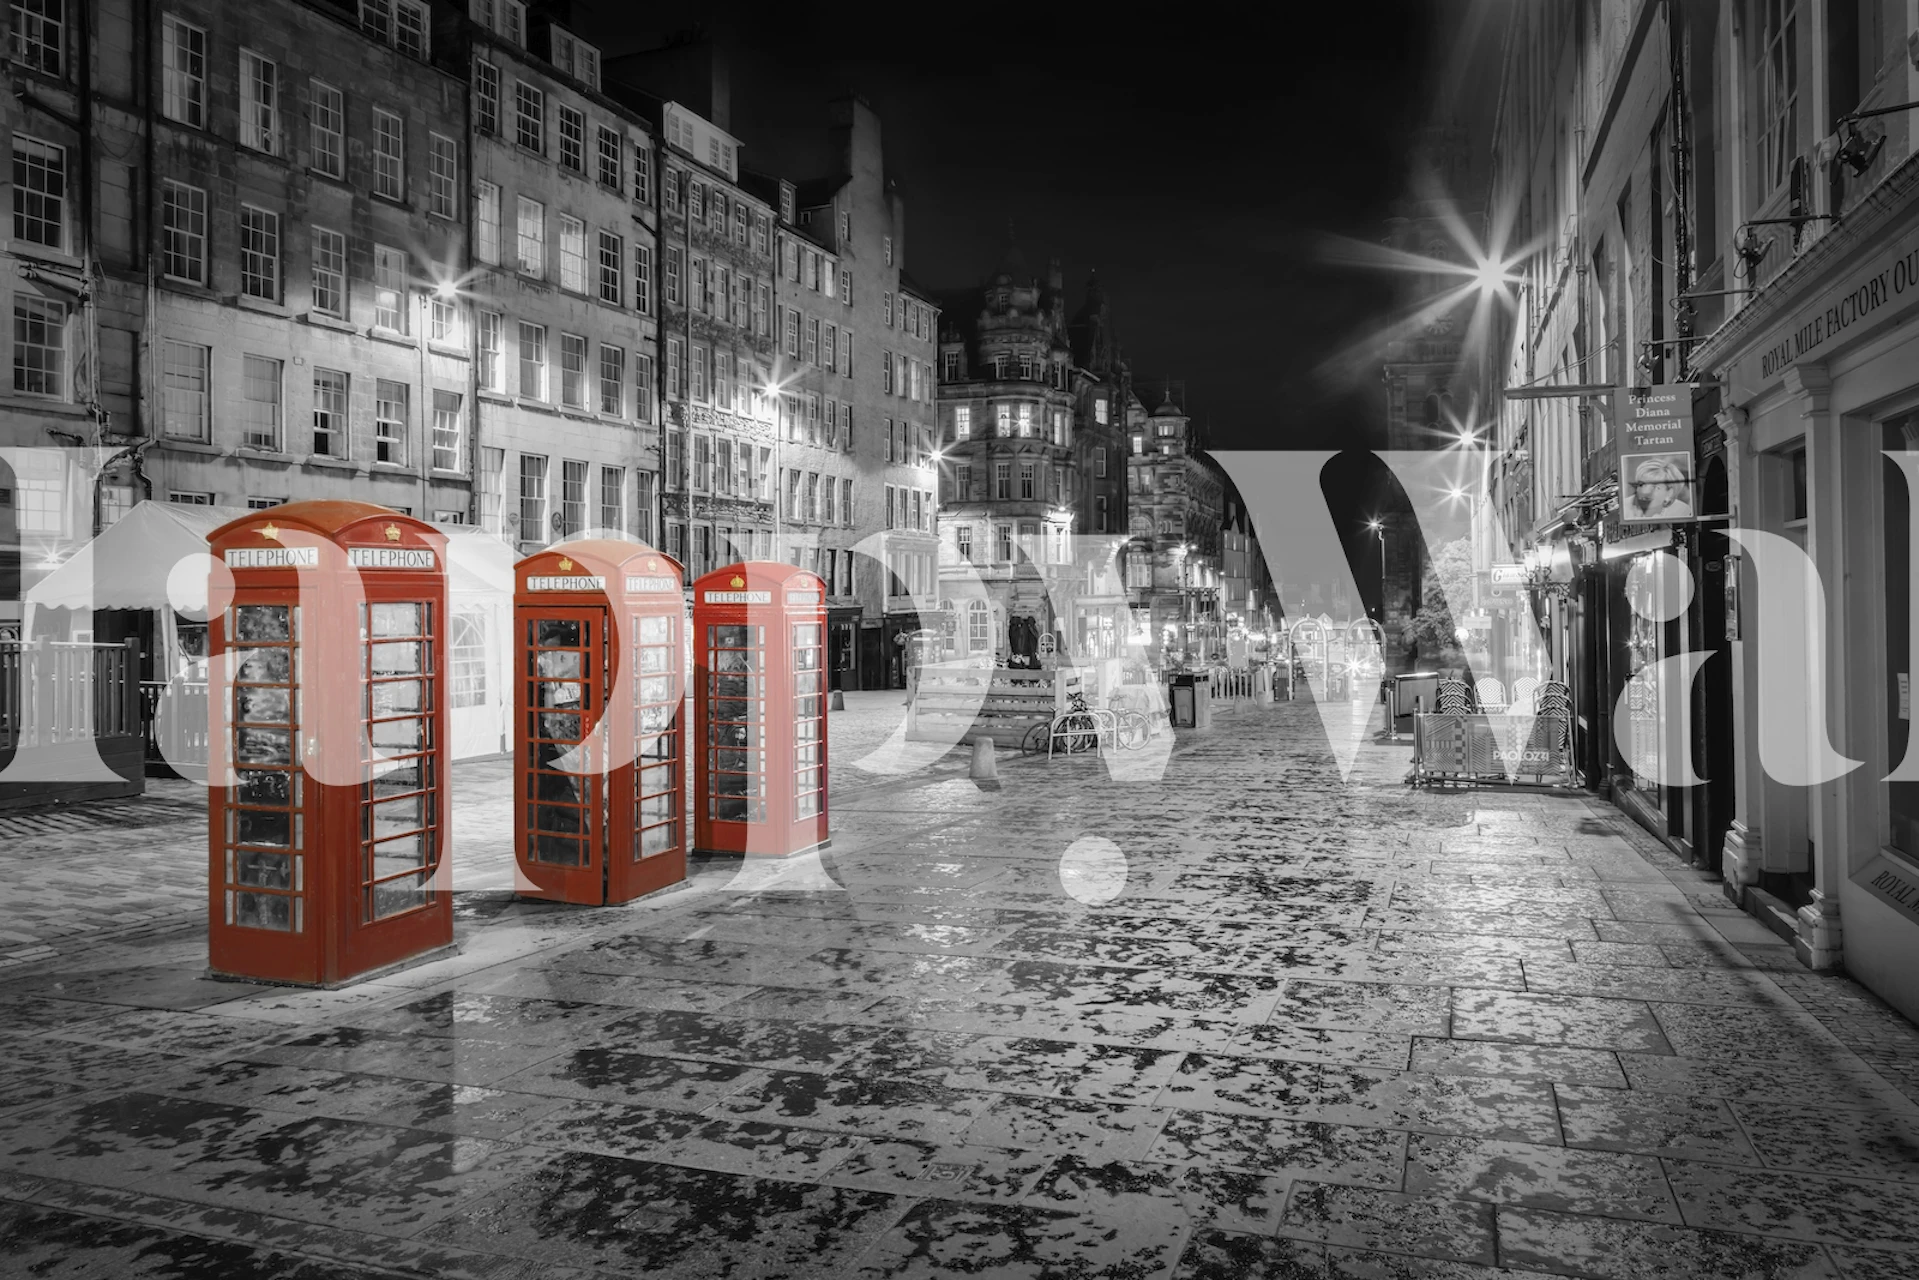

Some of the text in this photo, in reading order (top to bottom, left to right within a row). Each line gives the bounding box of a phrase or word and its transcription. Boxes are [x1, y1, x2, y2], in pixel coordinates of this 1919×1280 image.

[1761, 339, 1794, 380] ROYAL
[1794, 316, 1823, 358] MILE
[1826, 269, 1890, 339] FACTORY
[1628, 394, 1677, 405] Princess
[1635, 408, 1670, 418] Diana
[1625, 419, 1682, 433] Memorial
[1634, 435, 1674, 446] Tartan
[228, 549, 318, 567] TELEPHONE
[352, 550, 433, 568] TELEPHONE
[531, 577, 603, 589] TELEPHONE
[627, 577, 675, 591] TELEPHONE
[706, 592, 770, 603] TELEPHONE
[1492, 750, 1549, 762] PAOLOZZI
[1870, 870, 1917, 905] ROYAL
